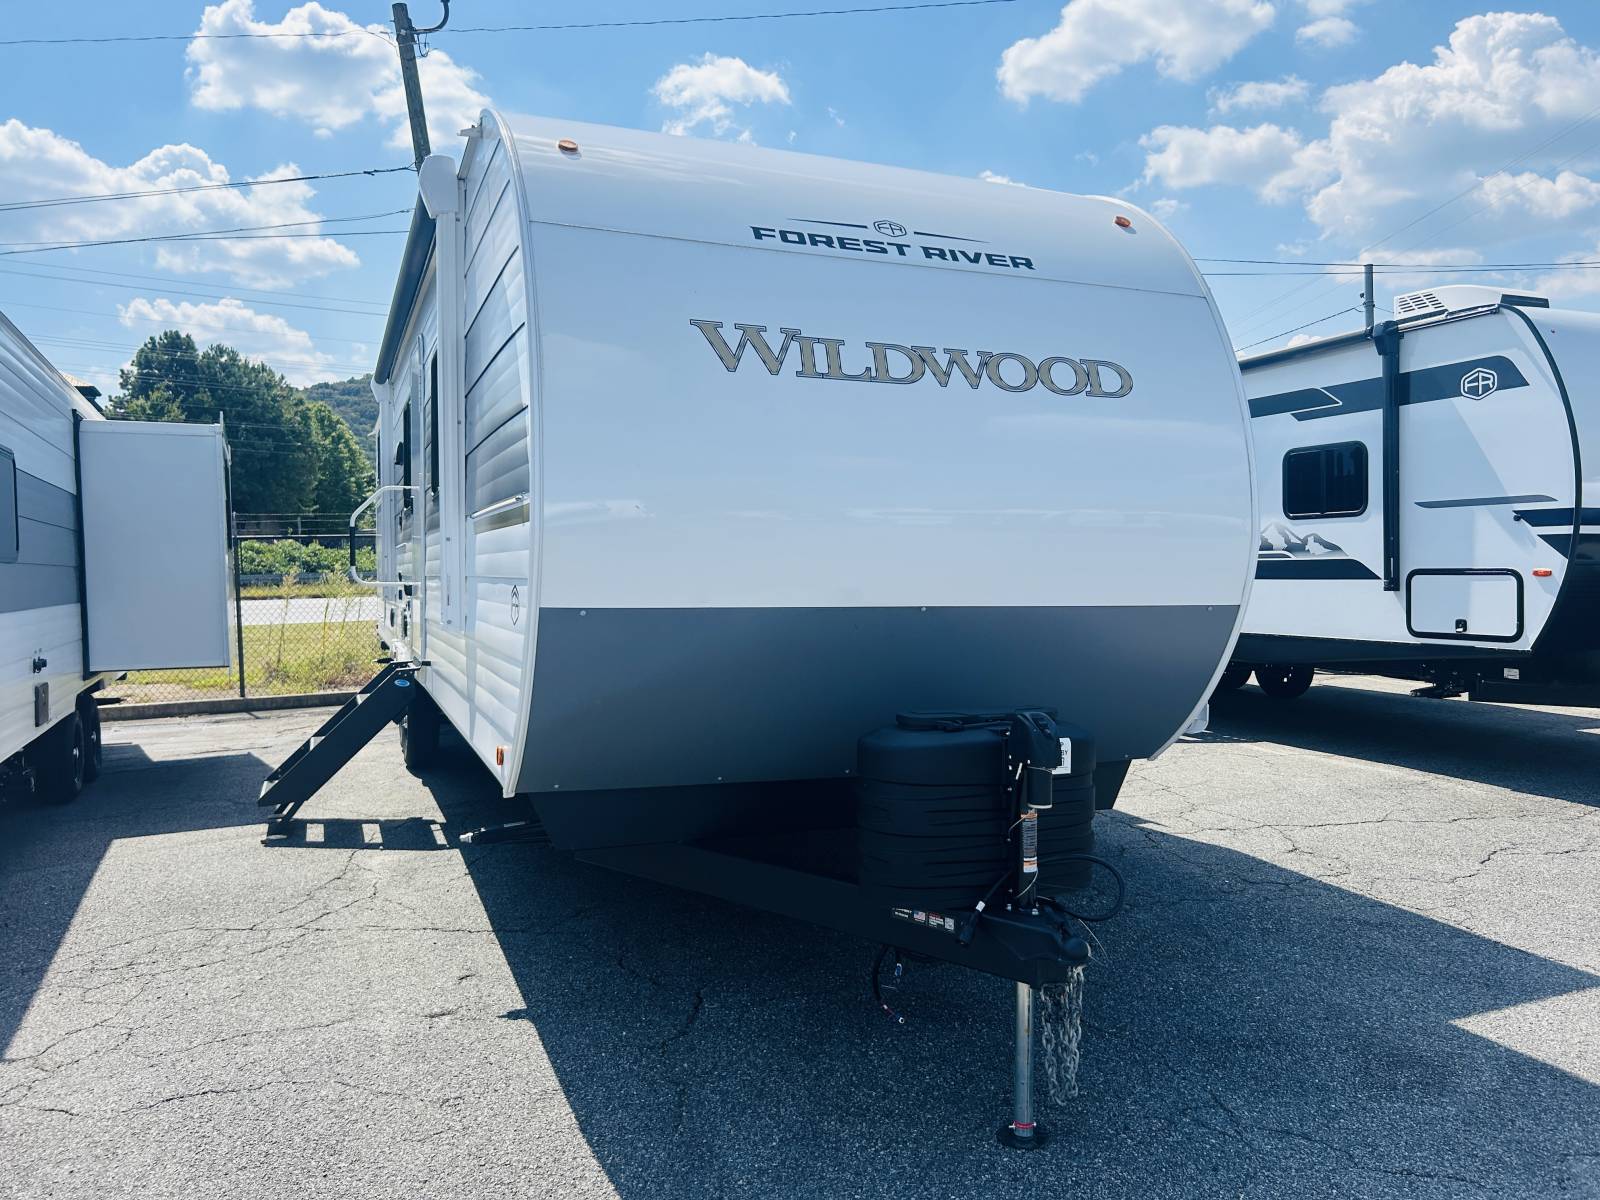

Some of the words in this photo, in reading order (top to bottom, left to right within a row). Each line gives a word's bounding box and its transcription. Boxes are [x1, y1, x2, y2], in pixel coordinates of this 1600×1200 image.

[750, 226, 911, 257] FOREST
[920, 246, 1036, 270] RIVER
[690, 319, 1134, 398] WILDWOOD
[1464, 371, 1494, 395] FR
